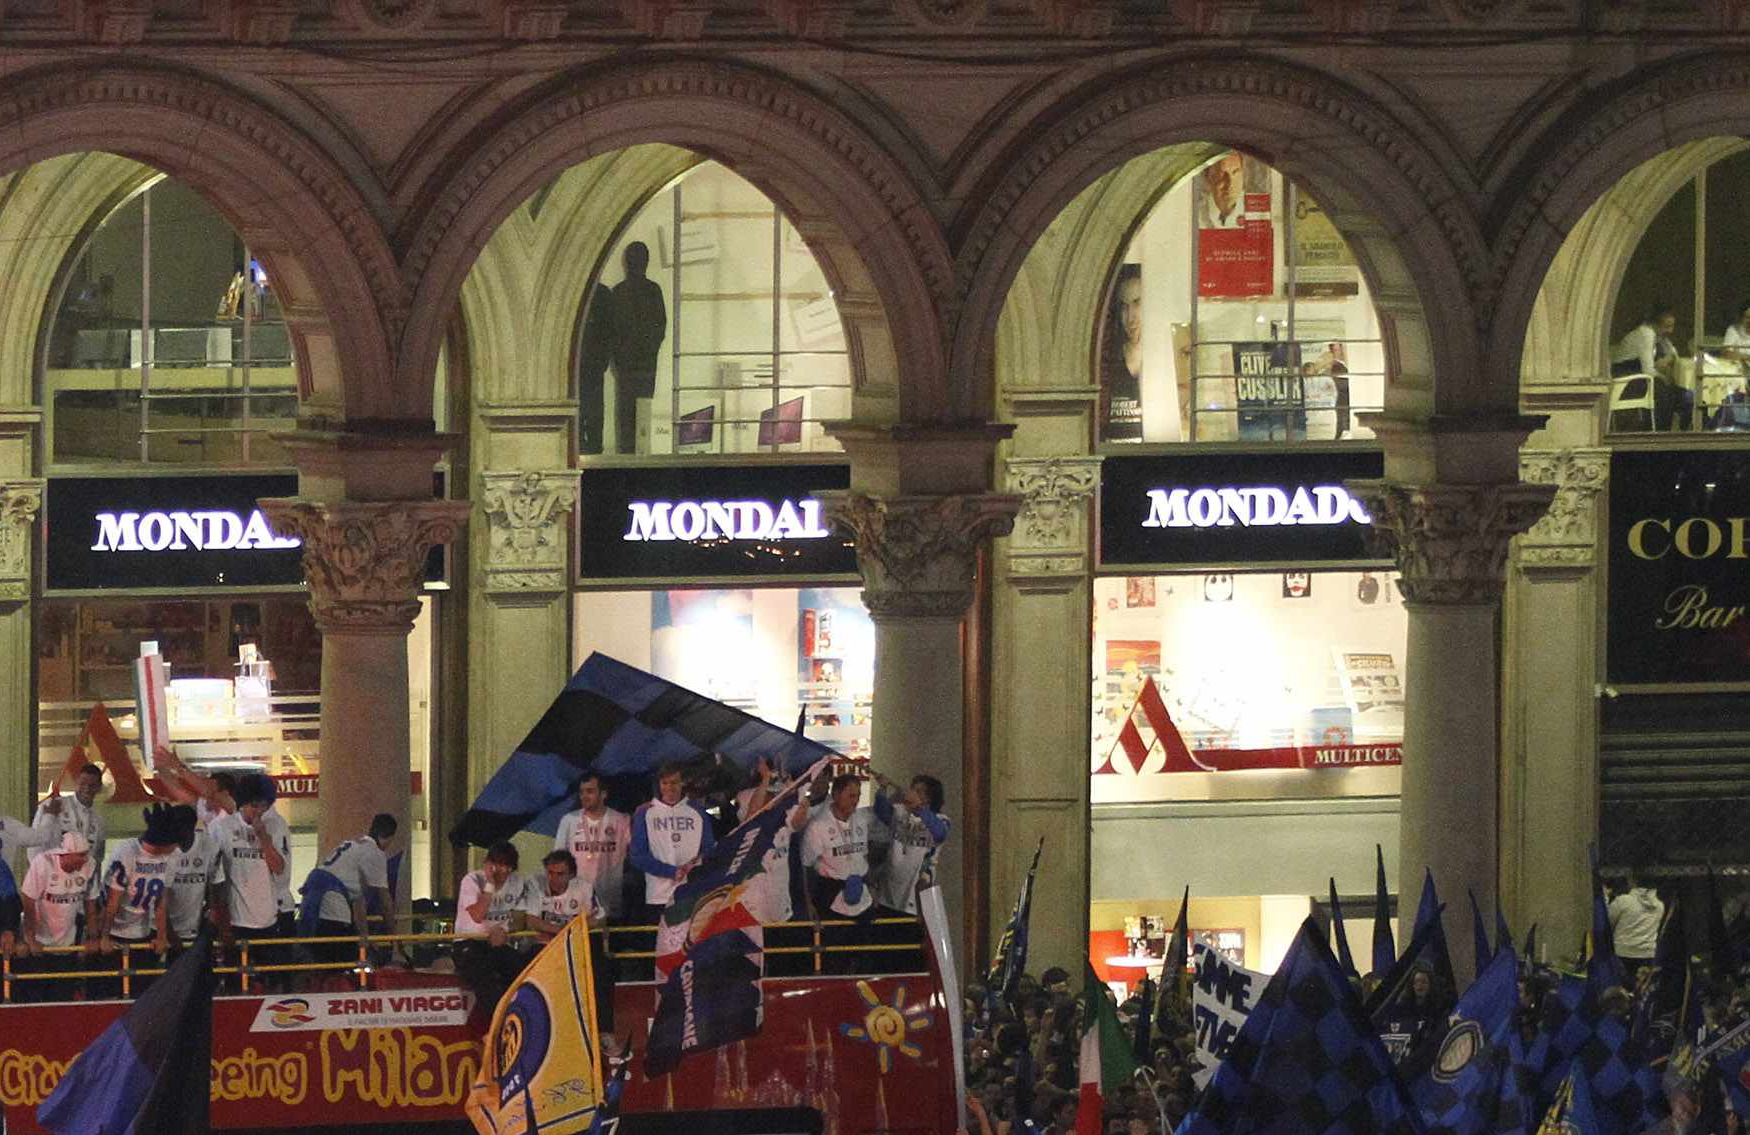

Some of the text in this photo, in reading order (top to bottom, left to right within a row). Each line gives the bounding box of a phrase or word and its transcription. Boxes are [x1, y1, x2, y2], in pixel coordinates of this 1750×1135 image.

[1237, 375, 1302, 401] CUSSLR
[90, 509, 301, 552] MONDA
[1655, 584, 1746, 630] Bar
[652, 816, 696, 832] INTER
[130, 877, 165, 911] 18
[327, 993, 468, 1015] ZANI VIAGGI
[319, 1027, 481, 1106] Milan
